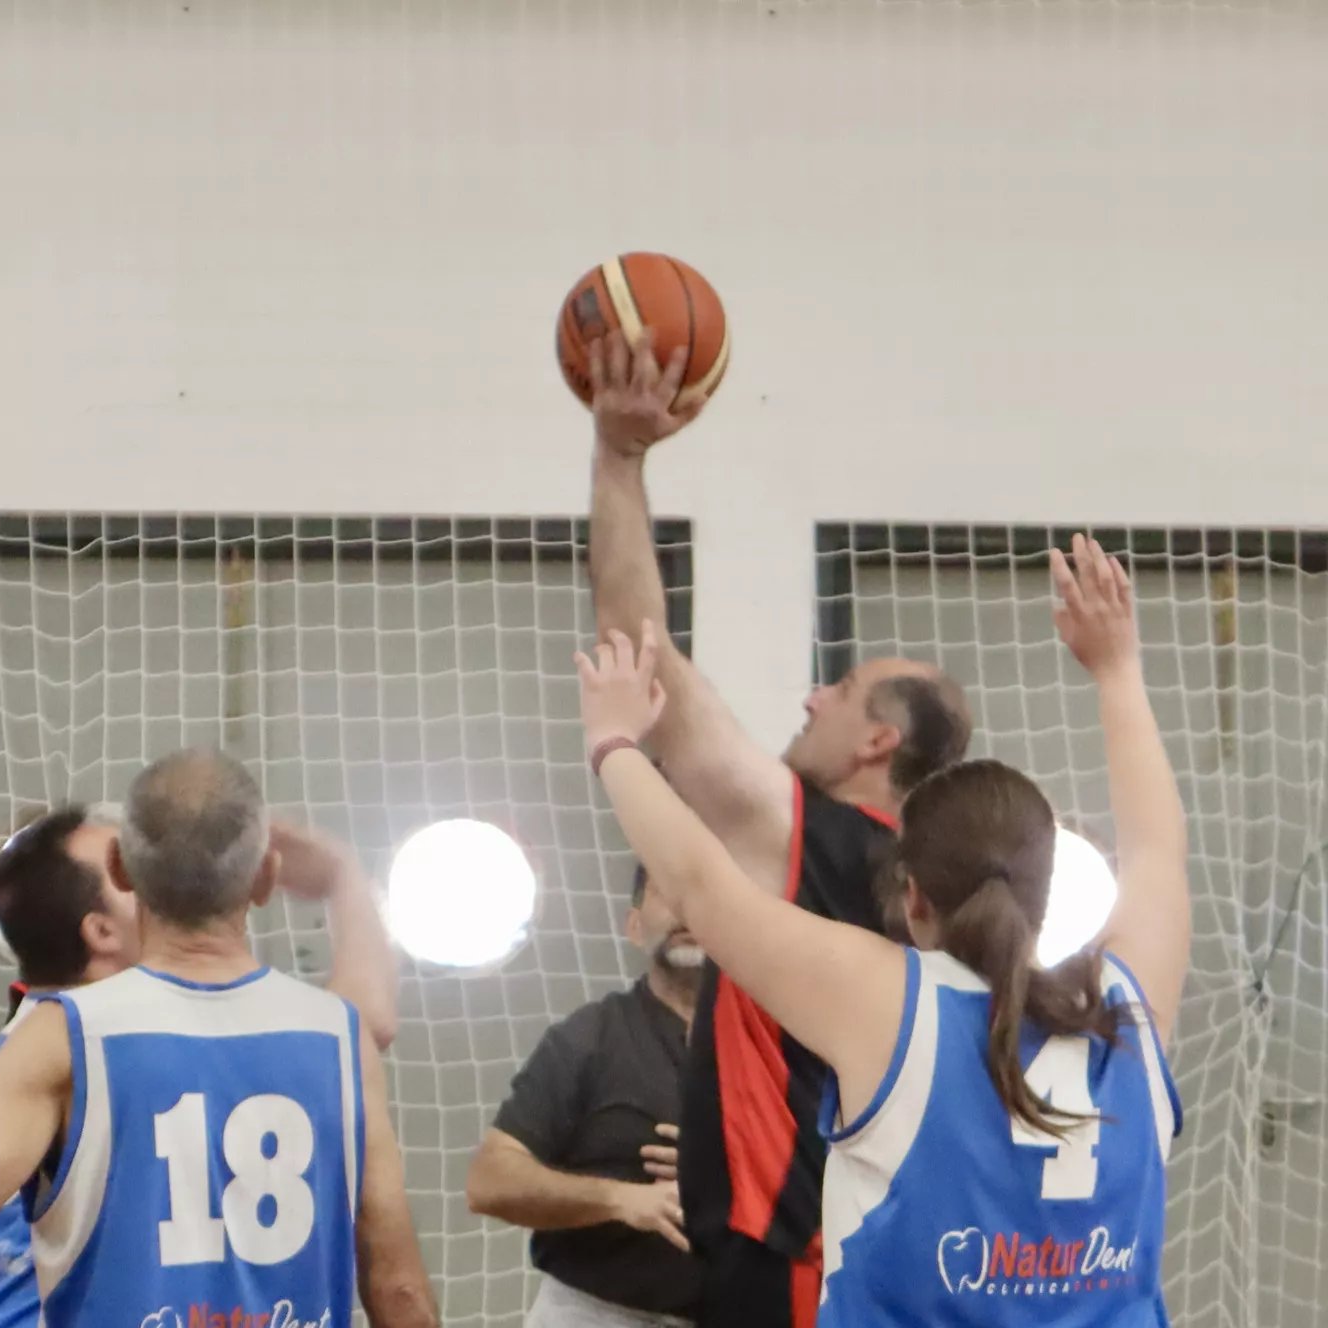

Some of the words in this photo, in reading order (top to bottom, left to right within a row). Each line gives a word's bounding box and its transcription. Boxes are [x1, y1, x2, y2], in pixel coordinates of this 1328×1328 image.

[153, 1092, 315, 1266] 18
[1009, 1036, 1101, 1200] 4
[988, 1226, 1138, 1281] NaturDent
